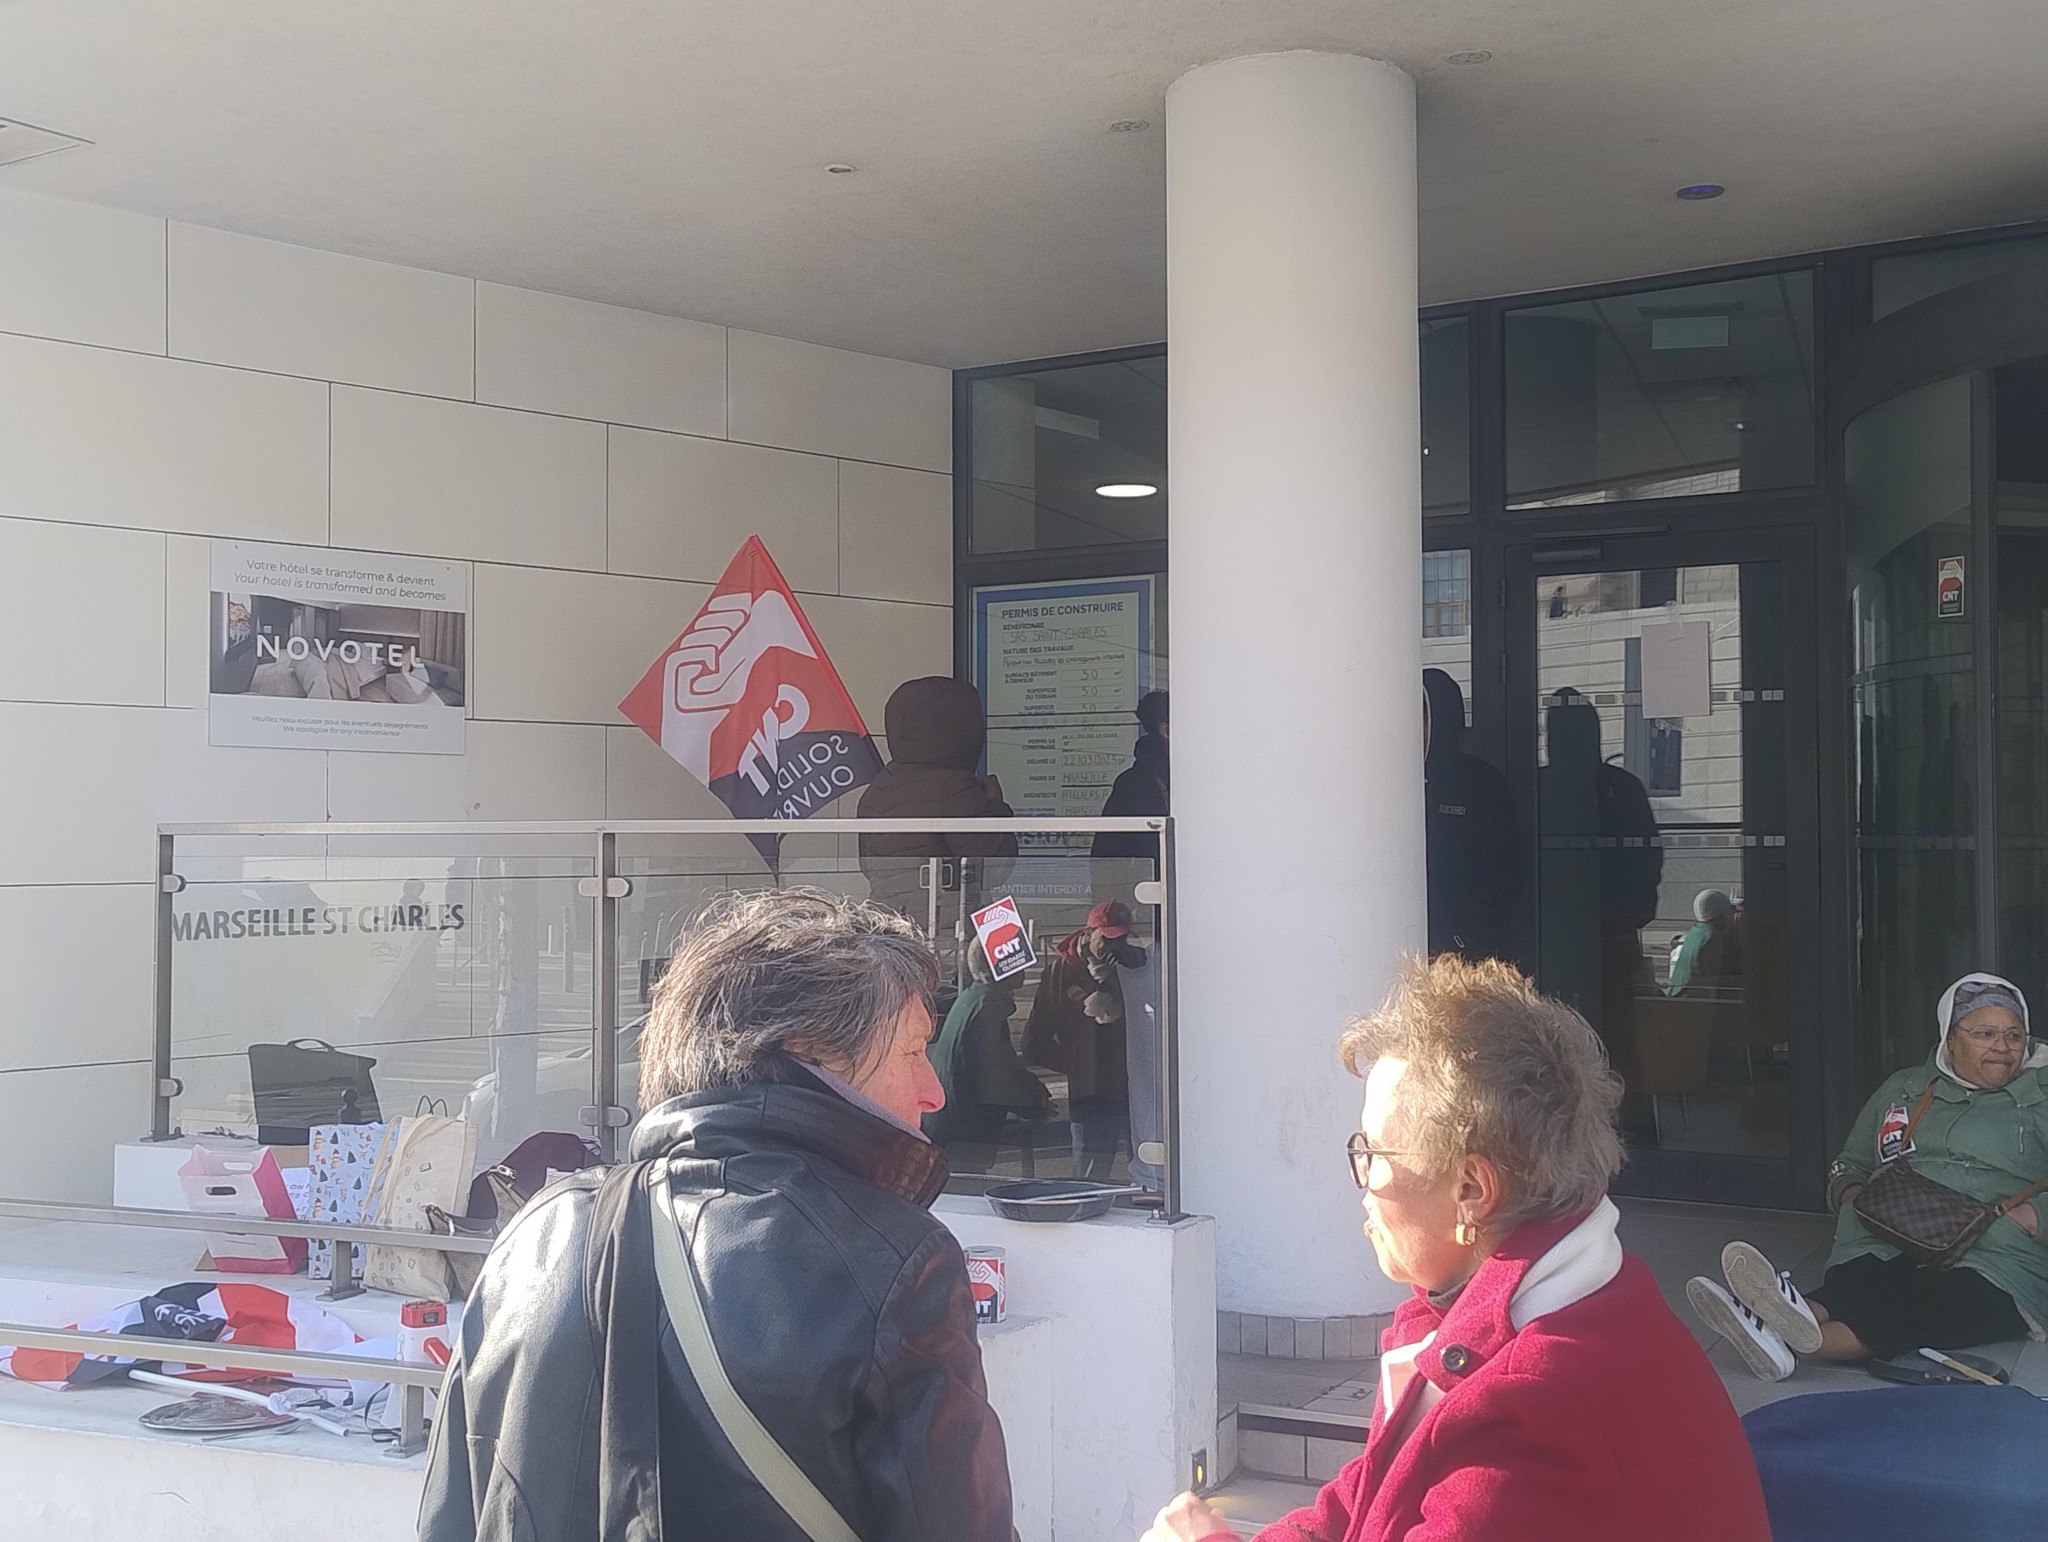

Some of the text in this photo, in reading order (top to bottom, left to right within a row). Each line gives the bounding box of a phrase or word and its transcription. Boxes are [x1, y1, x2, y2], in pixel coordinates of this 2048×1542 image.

[246, 559, 435, 586] Votre hôtel se transforme & devient
[234, 572, 446, 601] Your hotel is transformed and becomes
[1942, 590, 1959, 601] CNT
[1002, 602, 1124, 619] PERMIS DE CONSTRUIRE
[1010, 626, 1107, 643] SAS SAINT CHARLES
[256, 634, 425, 668] NOVOTEL
[1003, 647, 1028, 655] NATURE
[1044, 645, 1074, 653] TRAVAUX
[340, 728, 353, 736] any
[1063, 773, 1108, 784] MARSEILLE
[1038, 884, 1081, 894] INTERDIT
[173, 907, 316, 941] MARSEILLE
[359, 904, 465, 933] CHARLES
[993, 937, 1021, 960] CNT
